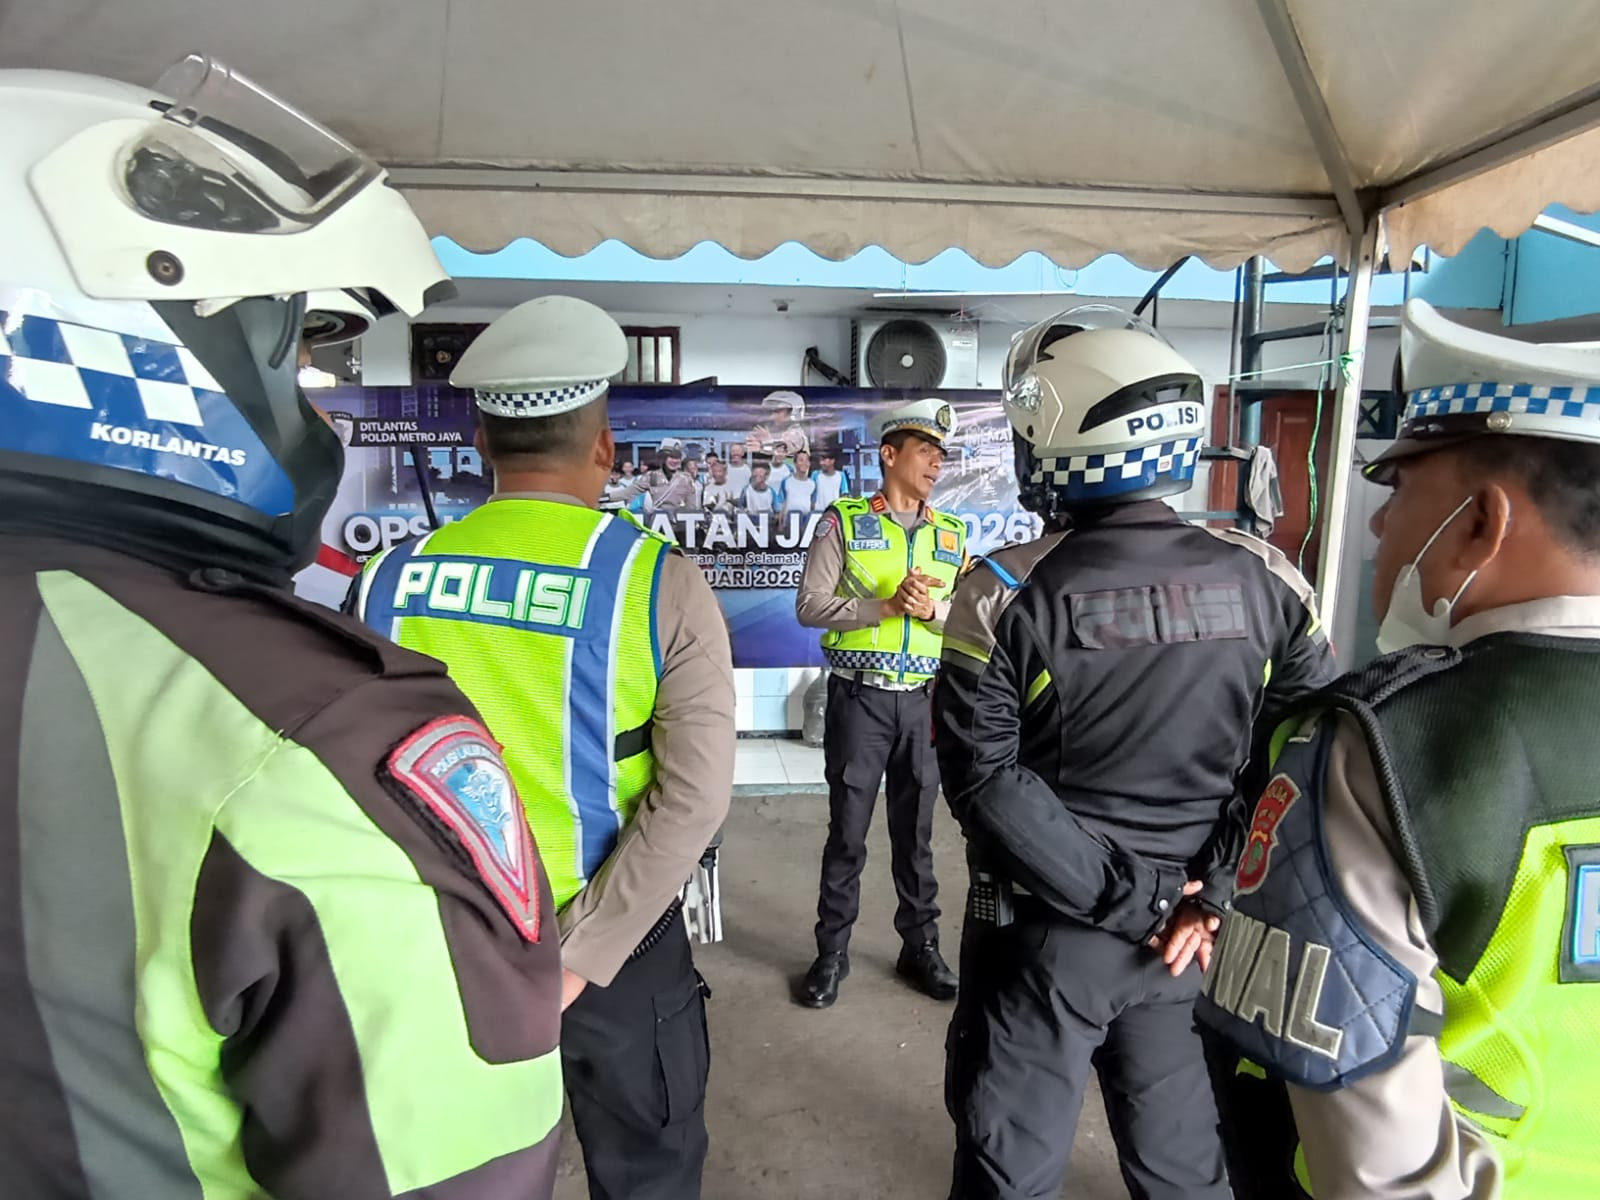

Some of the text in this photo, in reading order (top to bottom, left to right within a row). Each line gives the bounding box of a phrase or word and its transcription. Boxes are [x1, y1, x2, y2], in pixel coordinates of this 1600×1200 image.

[360, 421, 418, 432] DITLANTAS
[361, 431, 463, 443] POLDA METRO JAYA
[1126, 407, 1199, 437] POISI
[90, 421, 247, 467] KORLANTAS
[640, 512, 770, 549] ATAN
[775, 512, 823, 549] JA
[959, 512, 1032, 545] 026
[718, 552, 743, 565] dan
[745, 552, 801, 566] Selamat
[704, 569, 801, 587] UARI 2026
[393, 561, 592, 630] POLISI
[1204, 909, 1343, 1060] WAL
